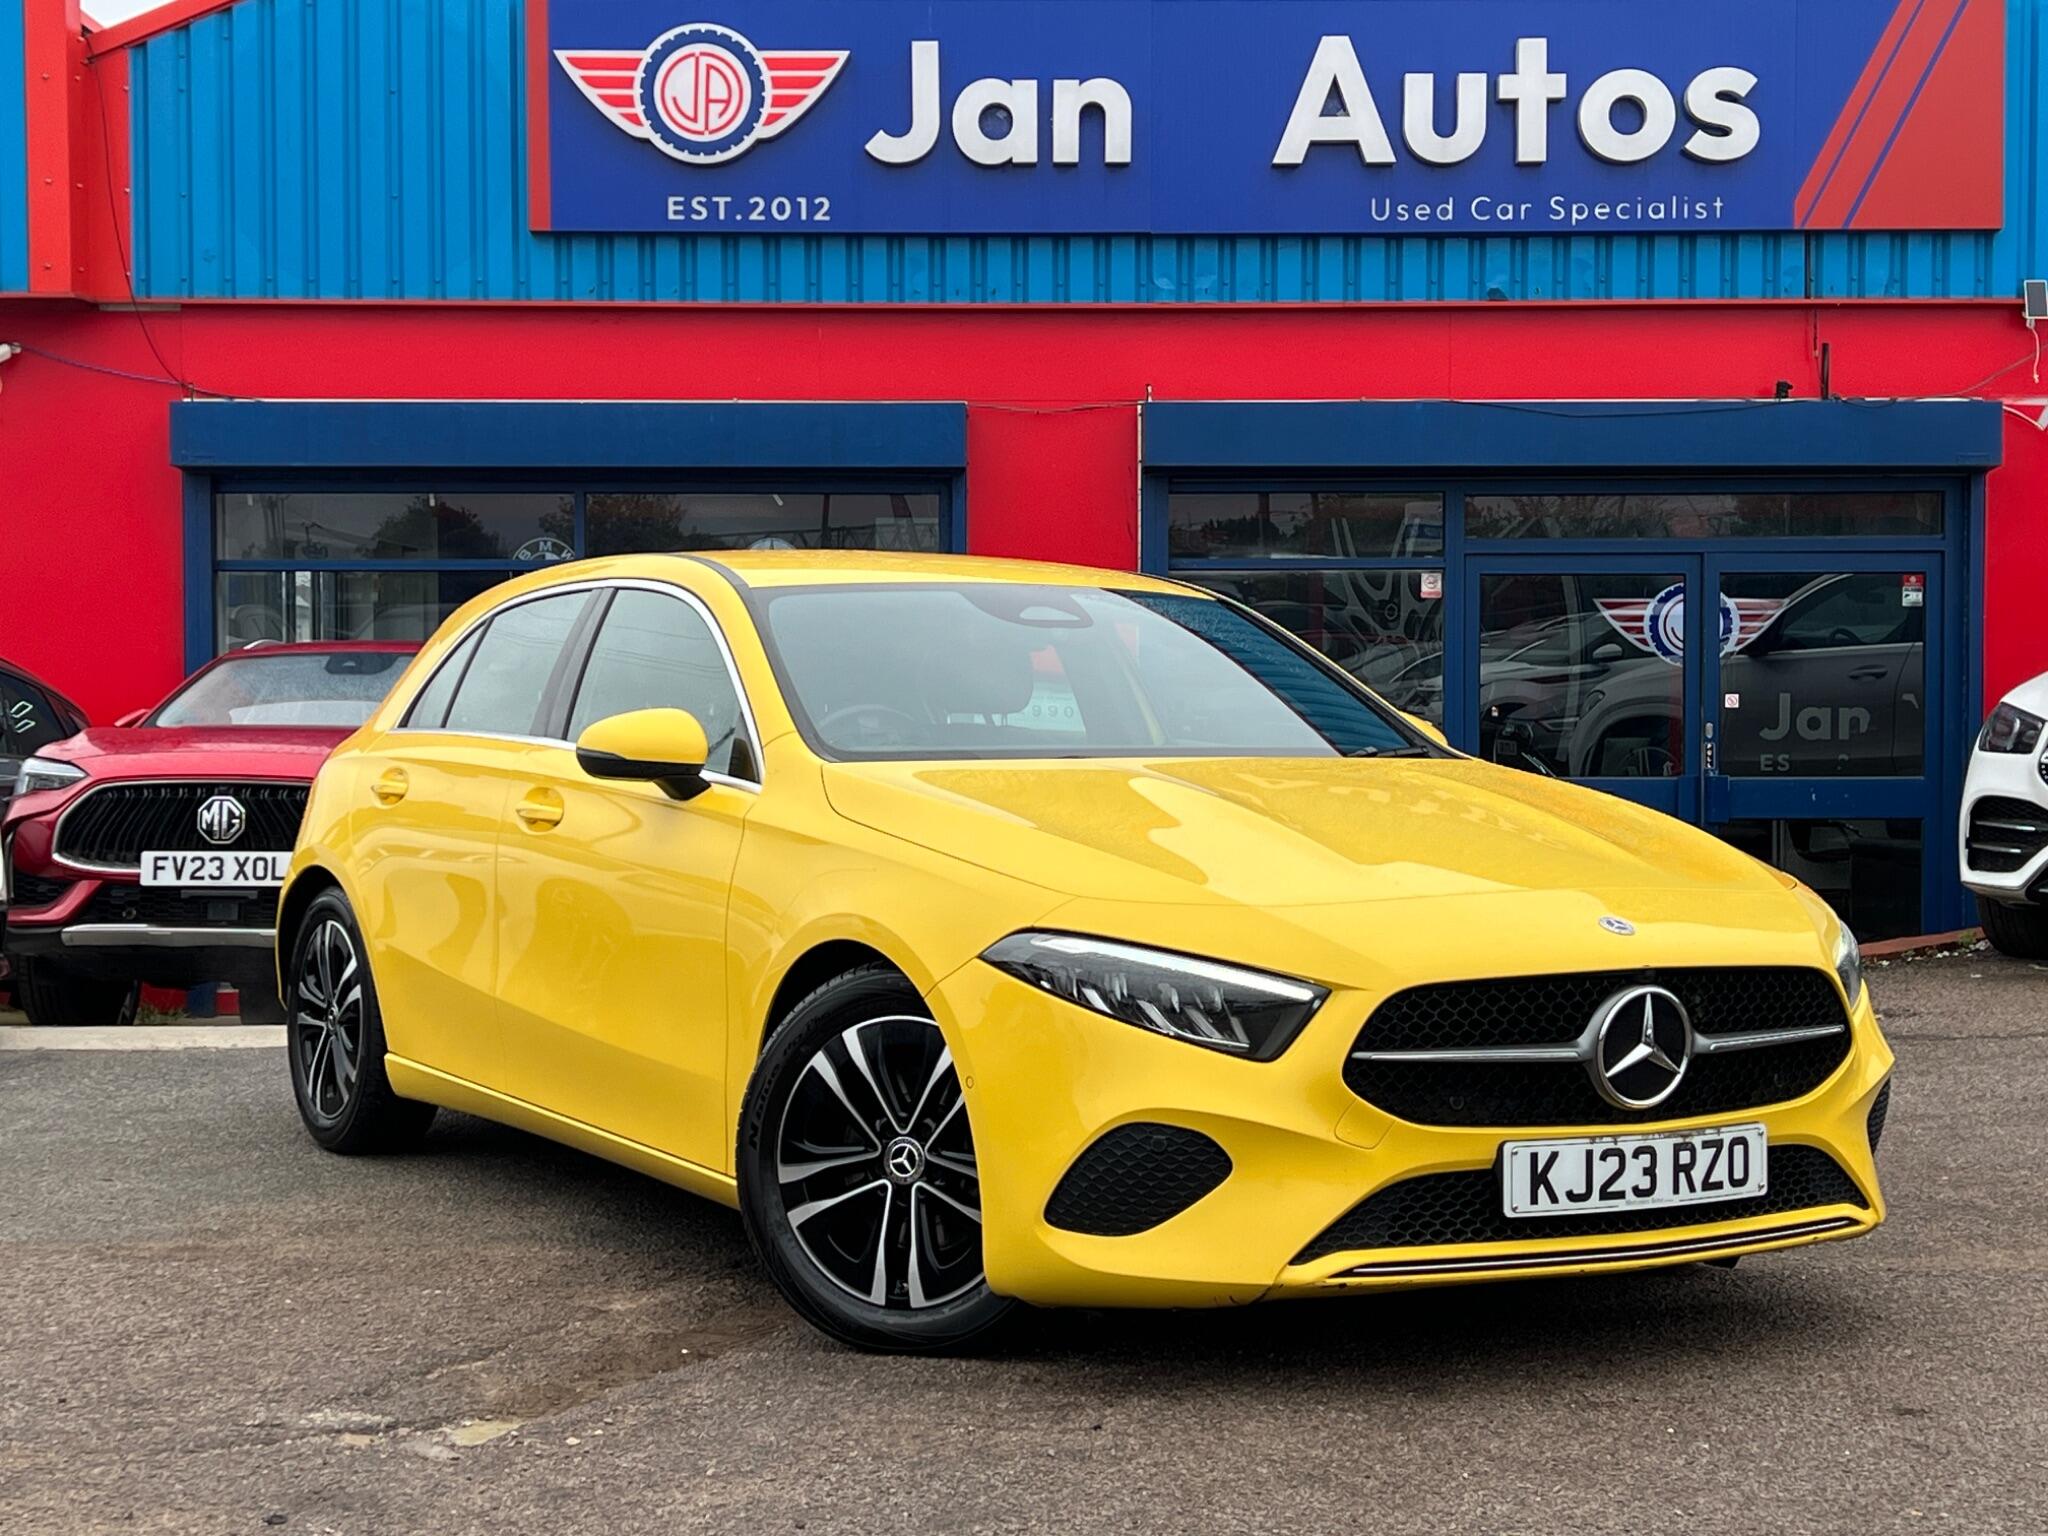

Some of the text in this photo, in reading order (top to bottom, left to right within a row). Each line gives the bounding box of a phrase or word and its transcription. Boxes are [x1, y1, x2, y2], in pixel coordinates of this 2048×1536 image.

[864, 36, 1761, 165] Jan Autos
[667, 196, 831, 221] EST.2012
[1371, 195, 1724, 226] Used Car Specialist
[1759, 692, 1871, 741] Jan
[201, 800, 241, 840] MG
[152, 856, 285, 881] FV23 XOL
[1530, 1136, 1750, 1206] KJ23 RZO
